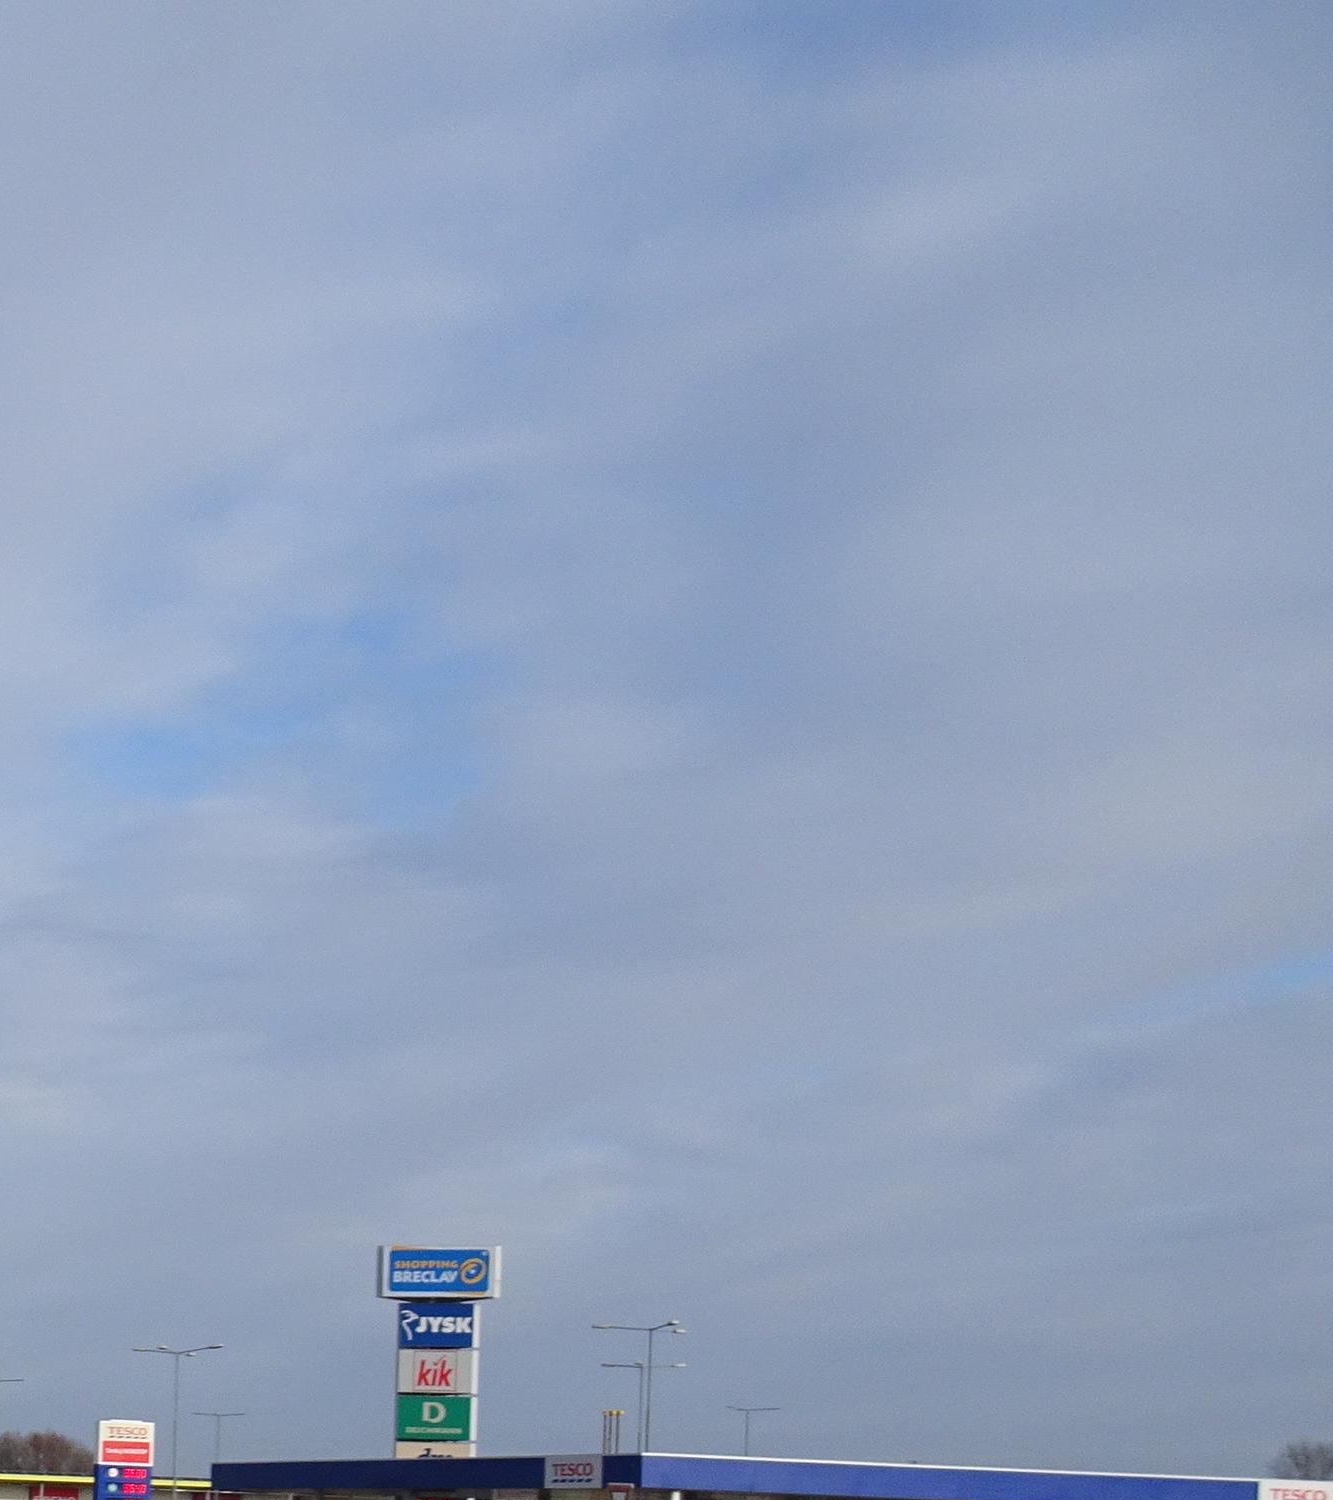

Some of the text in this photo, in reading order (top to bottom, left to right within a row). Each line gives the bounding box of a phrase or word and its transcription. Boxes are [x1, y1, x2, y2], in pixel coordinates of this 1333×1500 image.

[394, 1260, 458, 1269] SHOPPING
[415, 1317, 472, 1333] JYSK
[417, 1357, 453, 1386] kik
[421, 1402, 447, 1424] D
[106, 1426, 148, 1436] TESCO
[552, 1463, 593, 1477] TESCO
